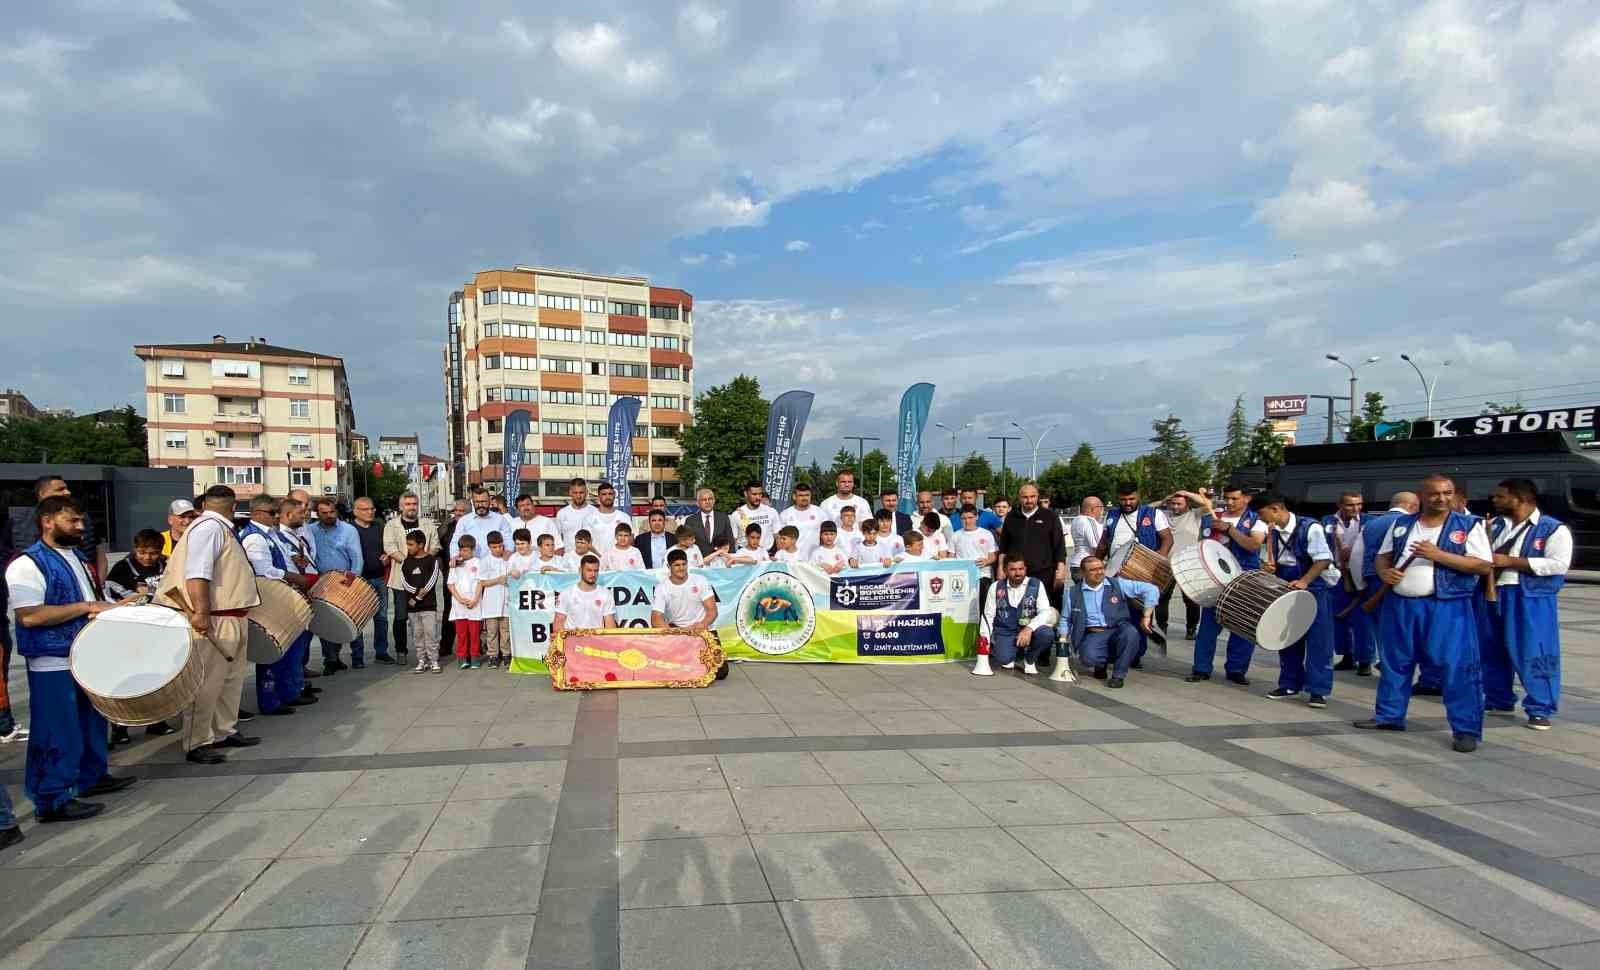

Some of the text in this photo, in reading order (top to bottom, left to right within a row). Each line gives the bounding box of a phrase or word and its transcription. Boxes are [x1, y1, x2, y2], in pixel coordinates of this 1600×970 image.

[1474, 408, 1595, 435] STORE
[519, 590, 545, 610] ER
[897, 617, 935, 628] HAZİRAN
